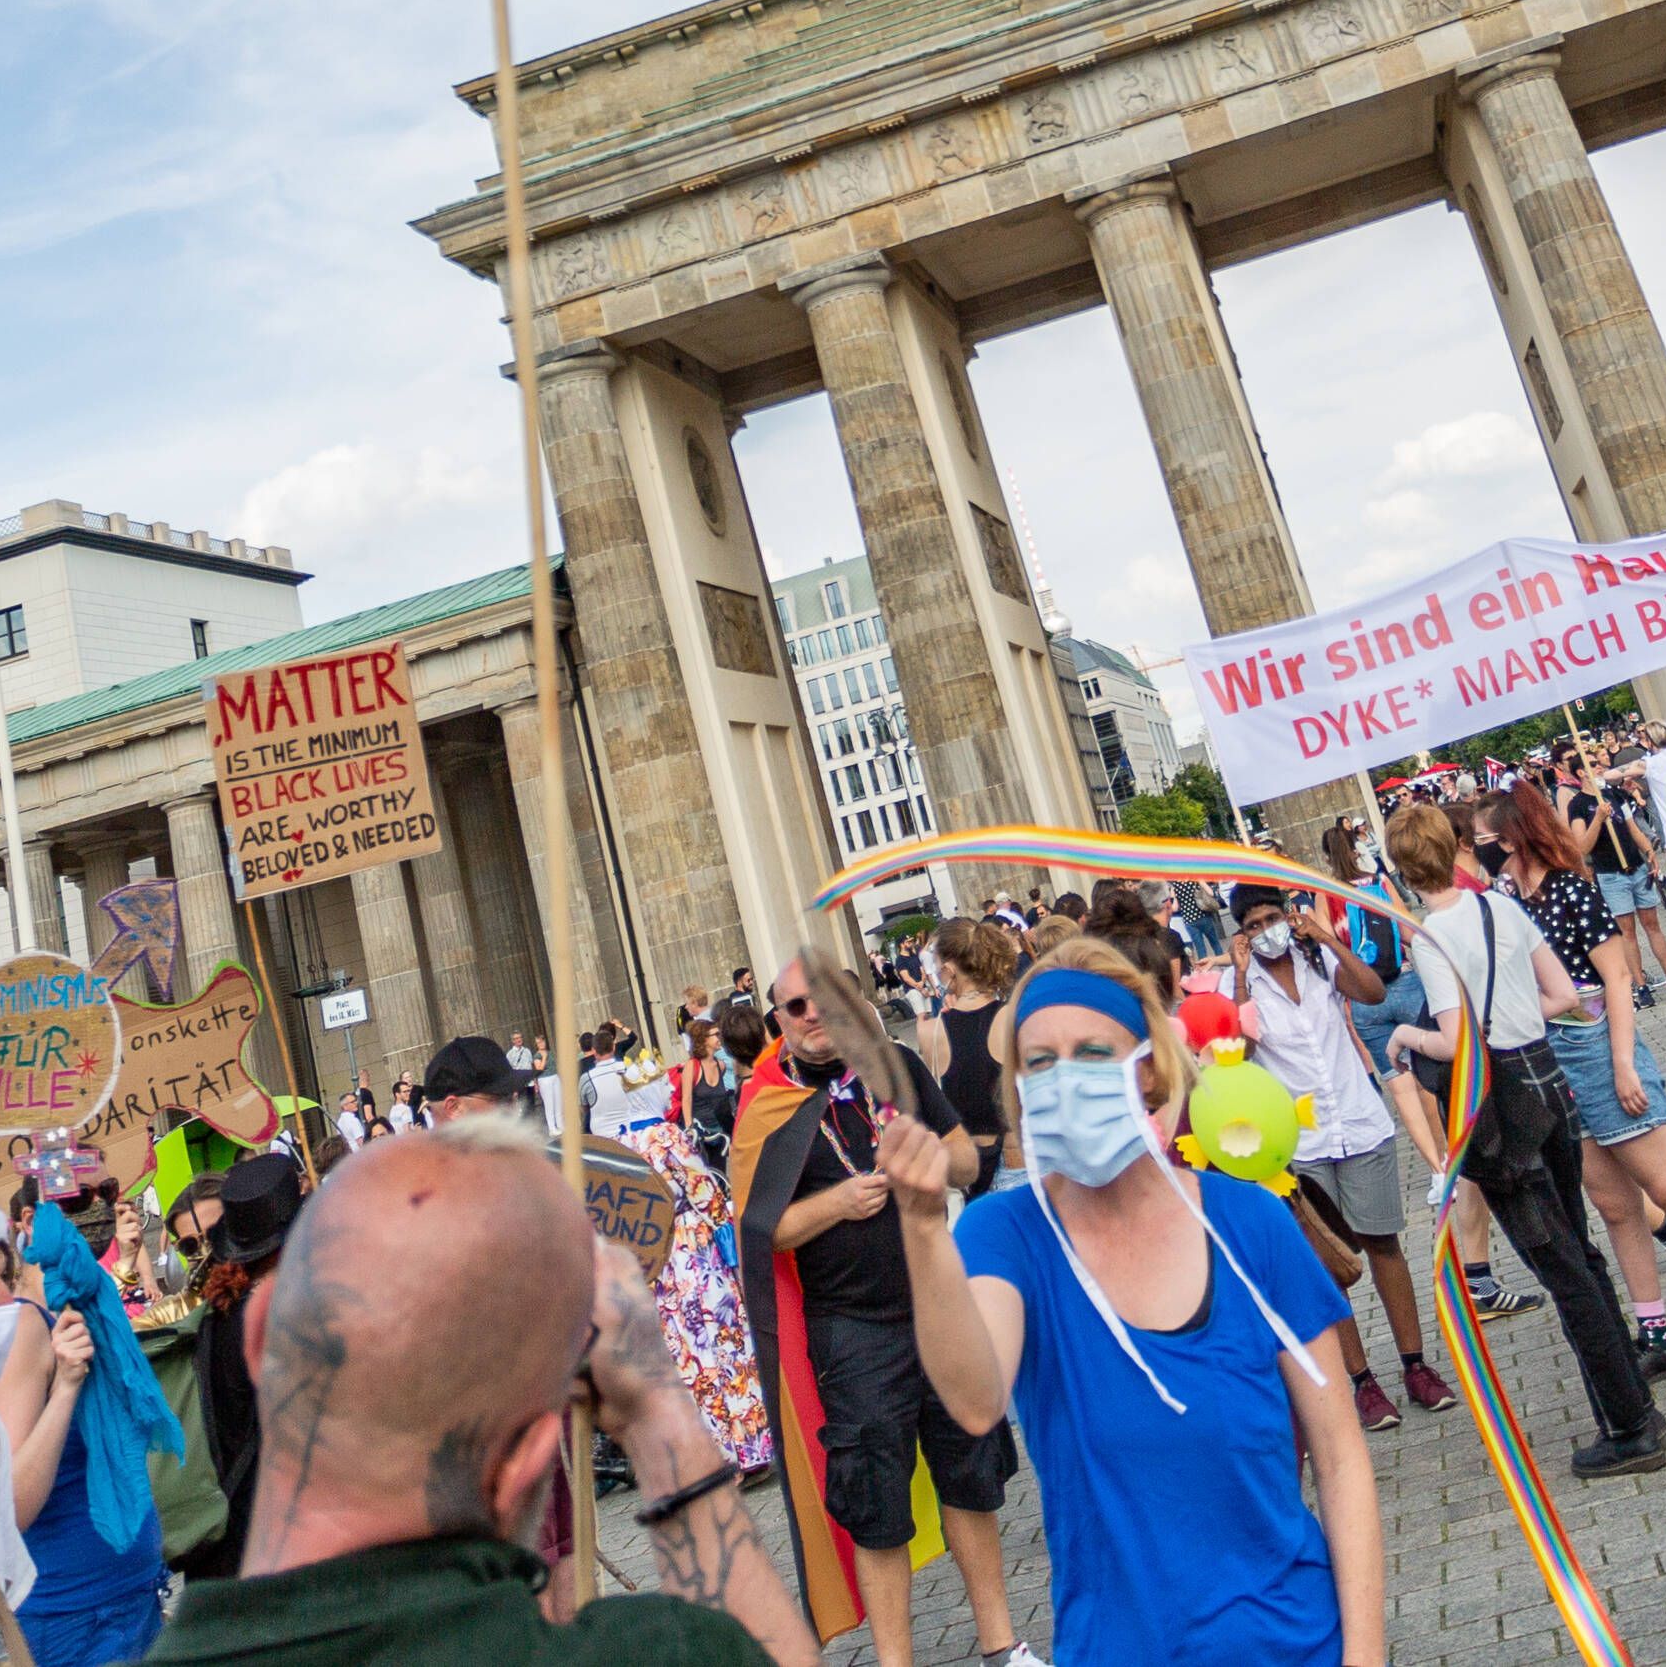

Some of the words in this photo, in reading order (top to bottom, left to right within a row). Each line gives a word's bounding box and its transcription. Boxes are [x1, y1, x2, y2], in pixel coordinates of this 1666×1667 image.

[1202, 648, 1305, 716] Wir
[1325, 593, 1454, 682] sind
[1468, 567, 1564, 631] ein
[1451, 613, 1627, 708] MARCH
[226, 753, 249, 774] IS
[252, 739, 303, 767] THE
[308, 720, 401, 758] MINIMUM
[231, 769, 327, 819] BLACK
[333, 751, 408, 793] LIVES
[239, 815, 290, 852] ARE
[307, 787, 415, 832] WORTHY
[242, 841, 329, 884] BELOVED
[332, 834, 349, 859] &
[351, 813, 436, 853] NEEDED
[130, 1003, 256, 1051] onskette
